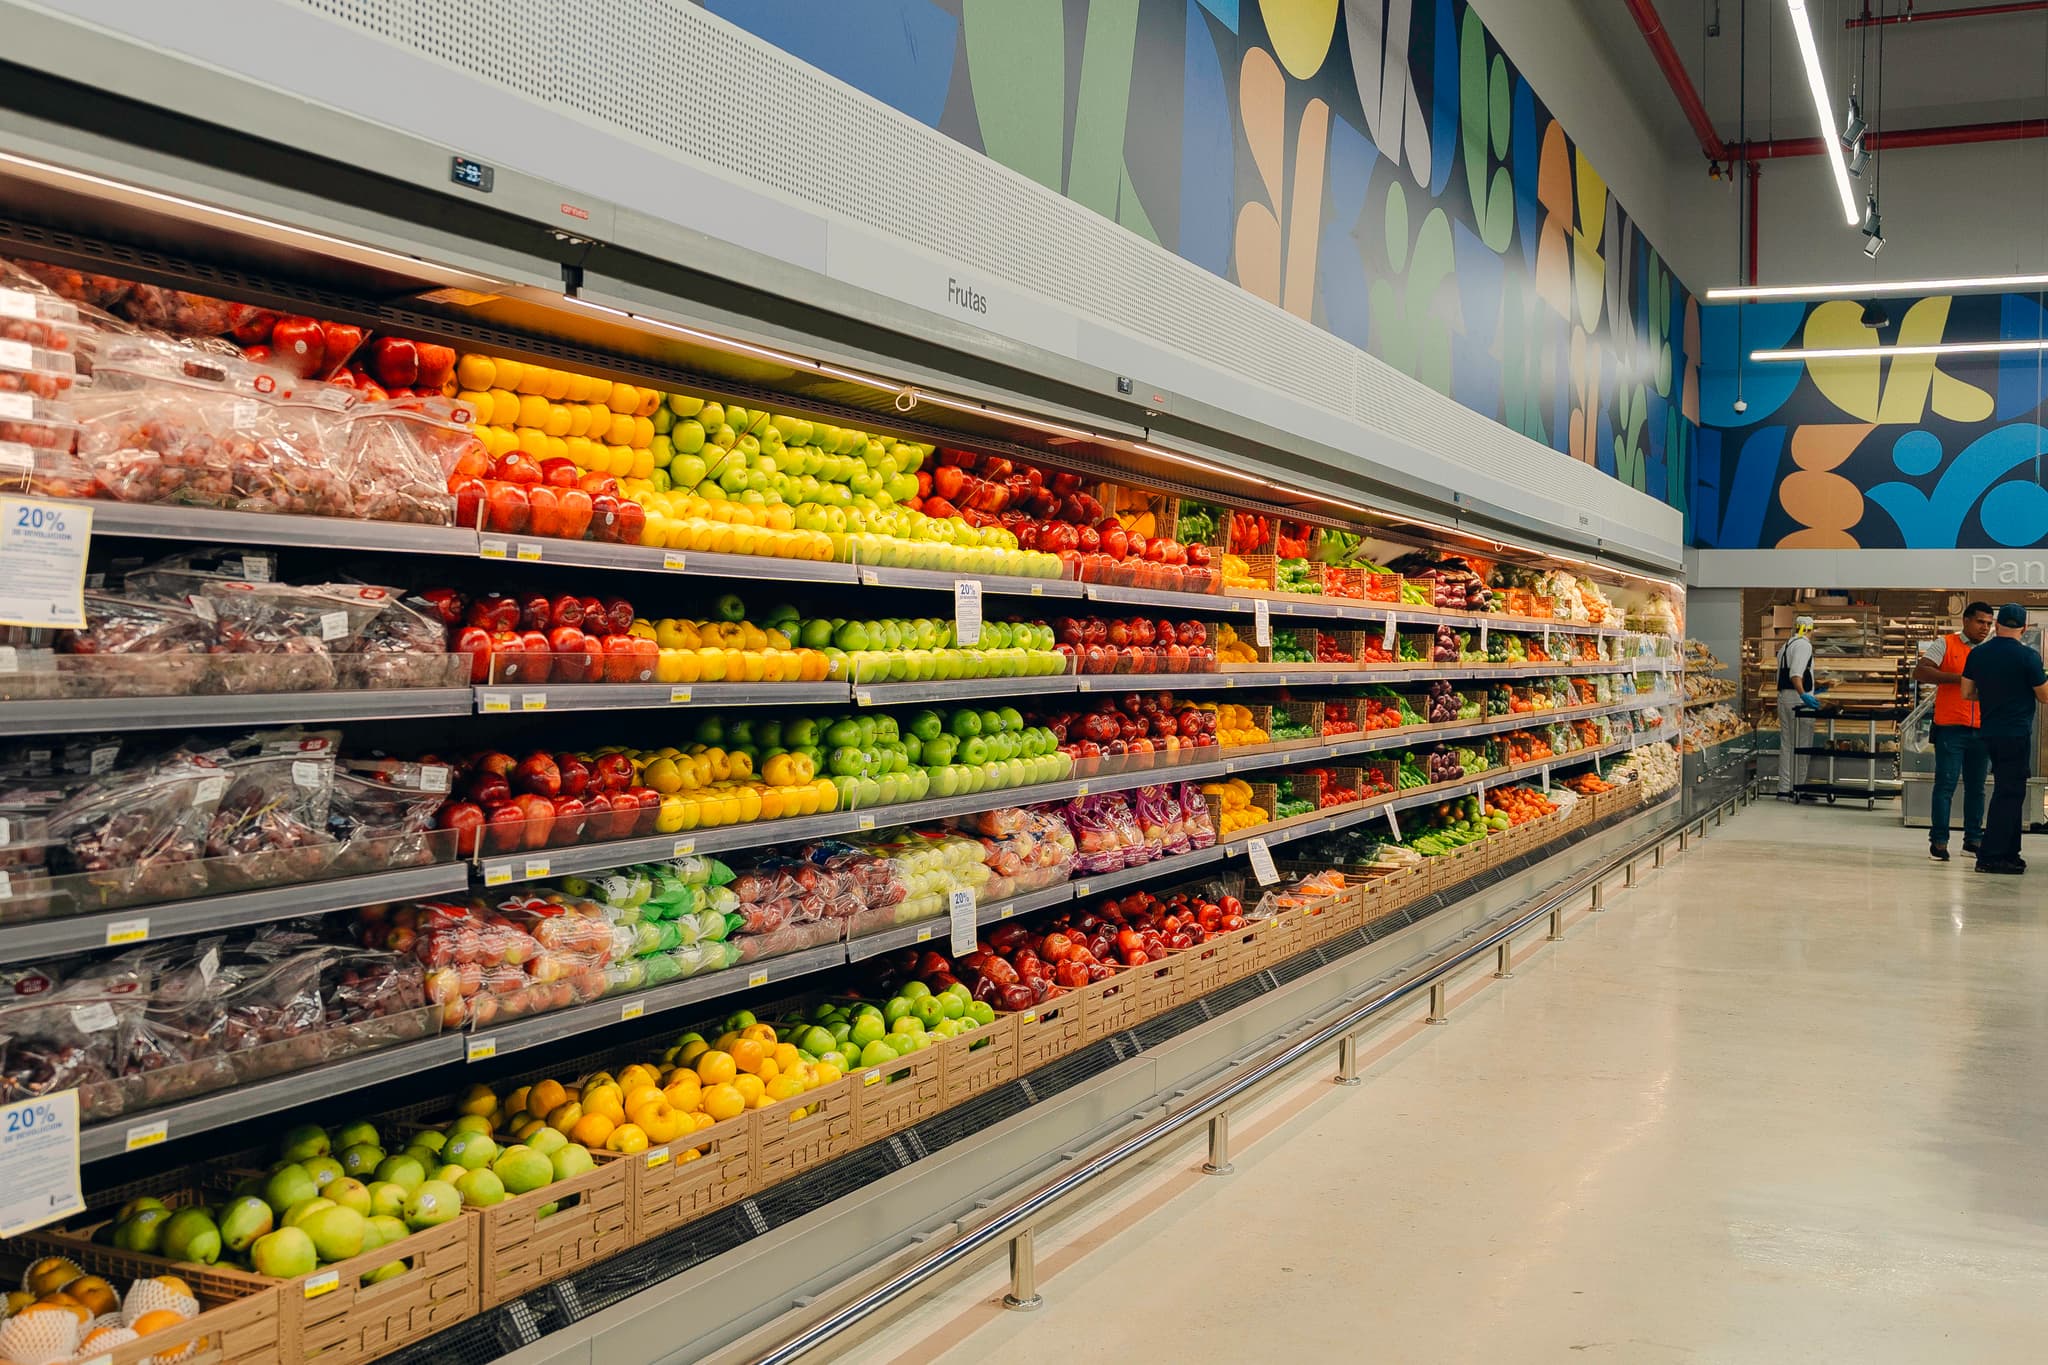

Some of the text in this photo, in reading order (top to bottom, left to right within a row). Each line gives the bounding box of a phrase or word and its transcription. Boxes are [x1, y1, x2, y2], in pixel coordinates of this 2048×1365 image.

[948, 277, 987, 314] Frutas
[17, 506, 66, 532] 20%
[960, 583, 976, 595] 20%
[954, 892, 970, 904] 20%
[7, 1103, 56, 1133] 20%
